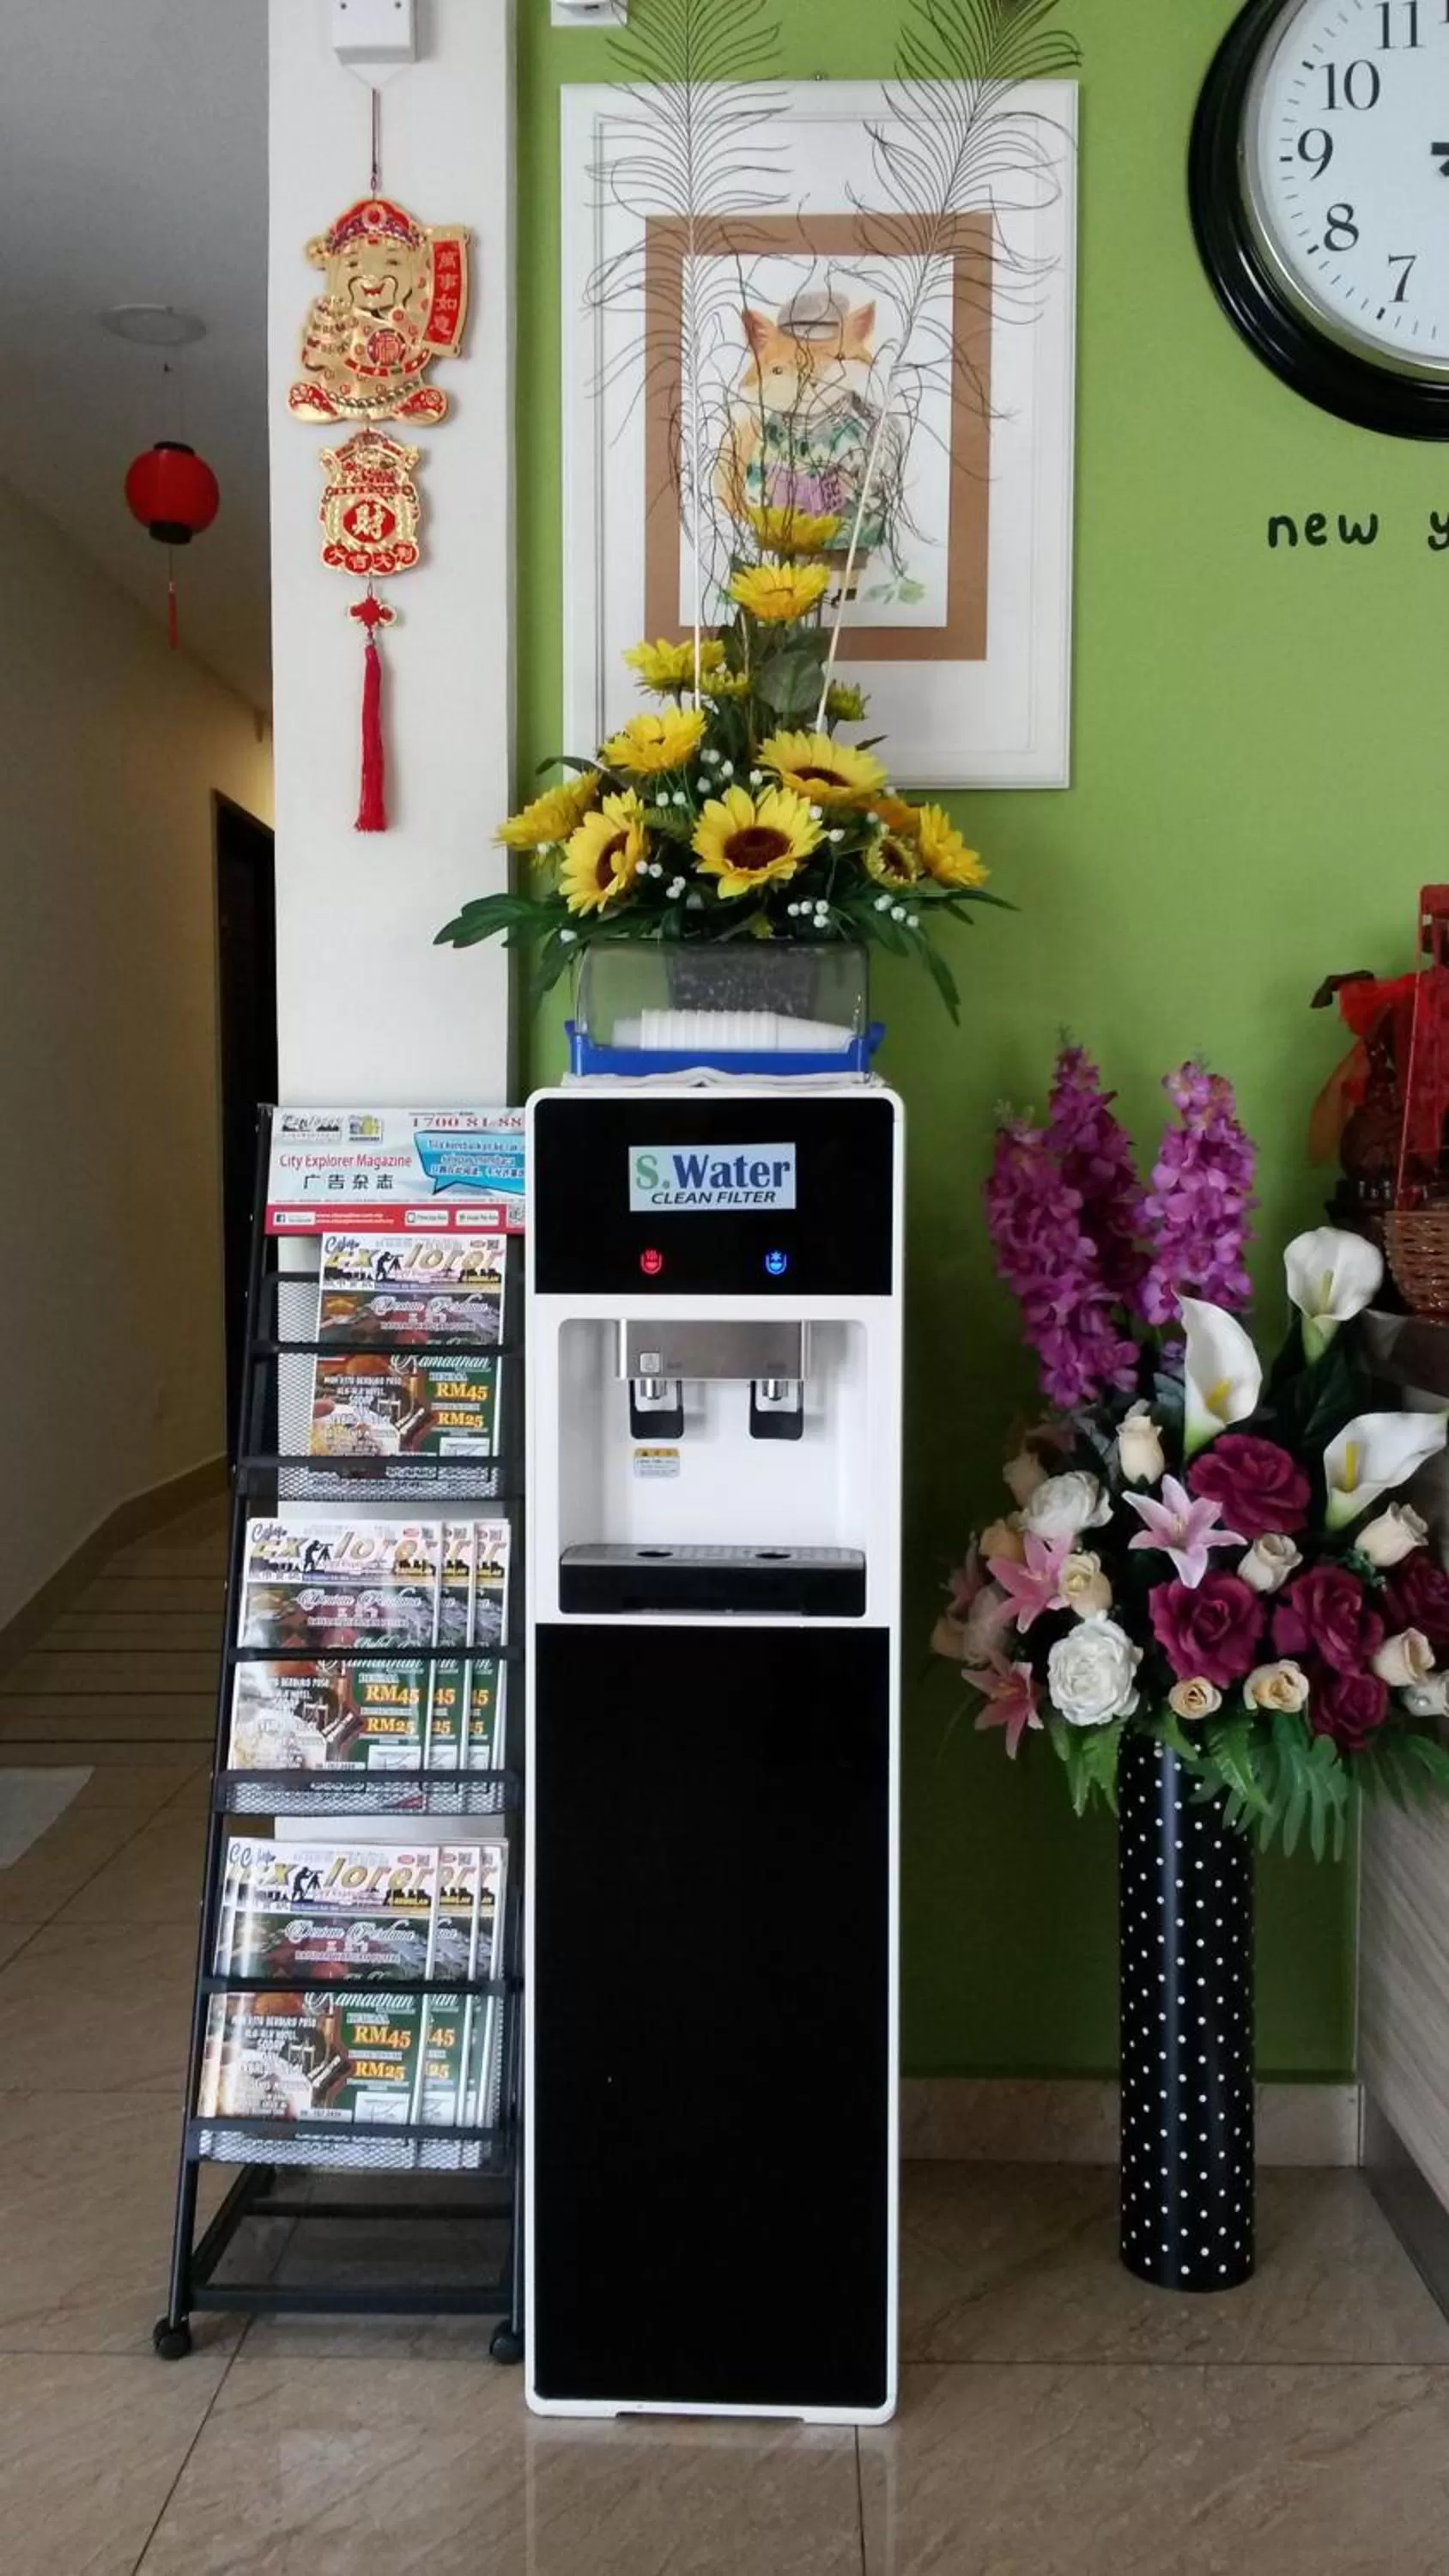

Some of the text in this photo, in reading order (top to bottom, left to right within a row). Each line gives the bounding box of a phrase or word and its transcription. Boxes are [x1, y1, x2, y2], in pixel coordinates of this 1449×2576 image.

[1373, 1, 1426, 49] 11
[1319, 59, 1380, 111] 10
[1297, 128, 1334, 179] 9
[1323, 203, 1360, 252] 8
[1387, 254, 1417, 302] 7
[1267, 512, 1379, 549] new
[279, 1154, 413, 1170] City Explorer Magazine
[303, 1174, 394, 1190] 广告杂志
[652, 1190, 777, 1206] CLEAN FILTER
[436, 1382, 488, 1400] RM45
[438, 1412, 484, 1429] RM25
[365, 1685, 420, 1705] RM45
[367, 1716, 415, 1735] RM25
[353, 2025, 412, 2049] RM45
[354, 2061, 406, 2081] RM25
